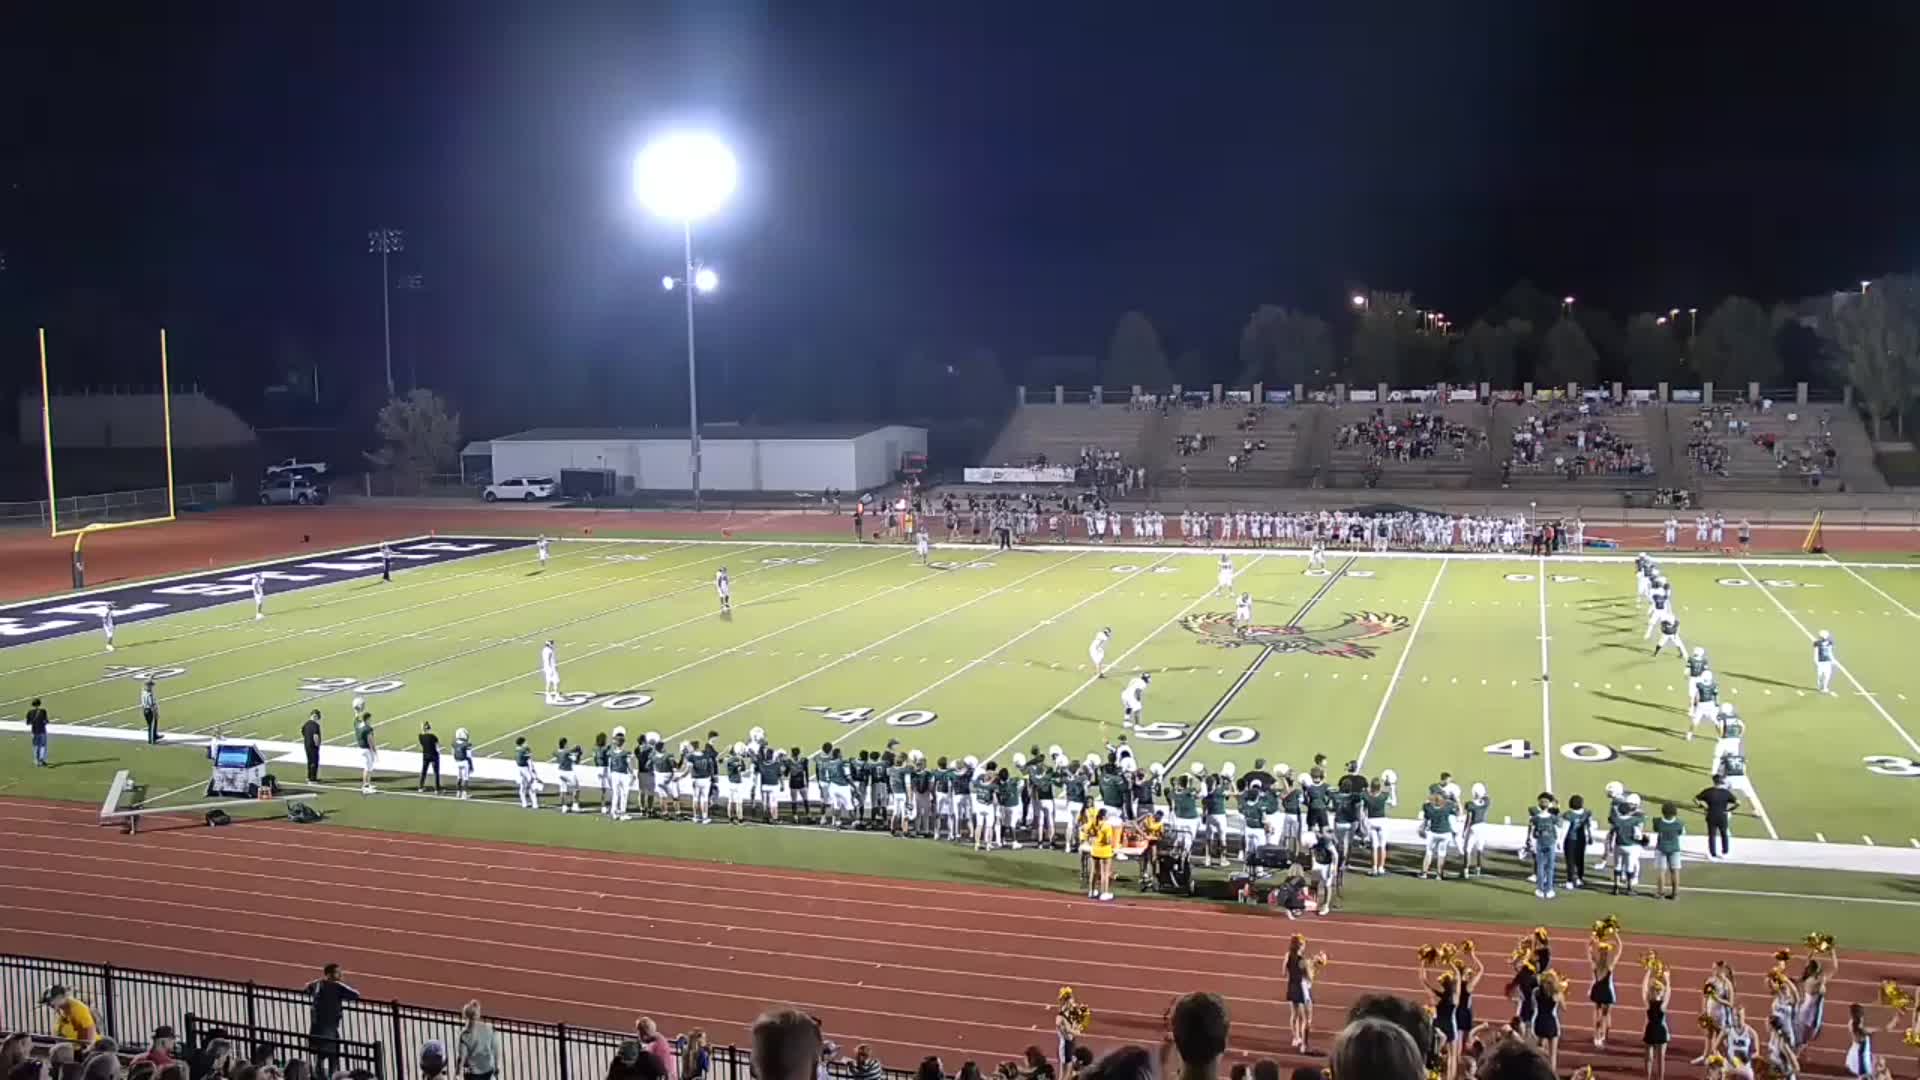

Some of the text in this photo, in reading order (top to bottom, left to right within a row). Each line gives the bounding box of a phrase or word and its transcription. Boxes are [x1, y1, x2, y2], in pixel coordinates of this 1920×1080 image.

[821, 708, 938, 727] 40
[1133, 722, 1259, 744] 50
[1482, 738, 1617, 763] 40
